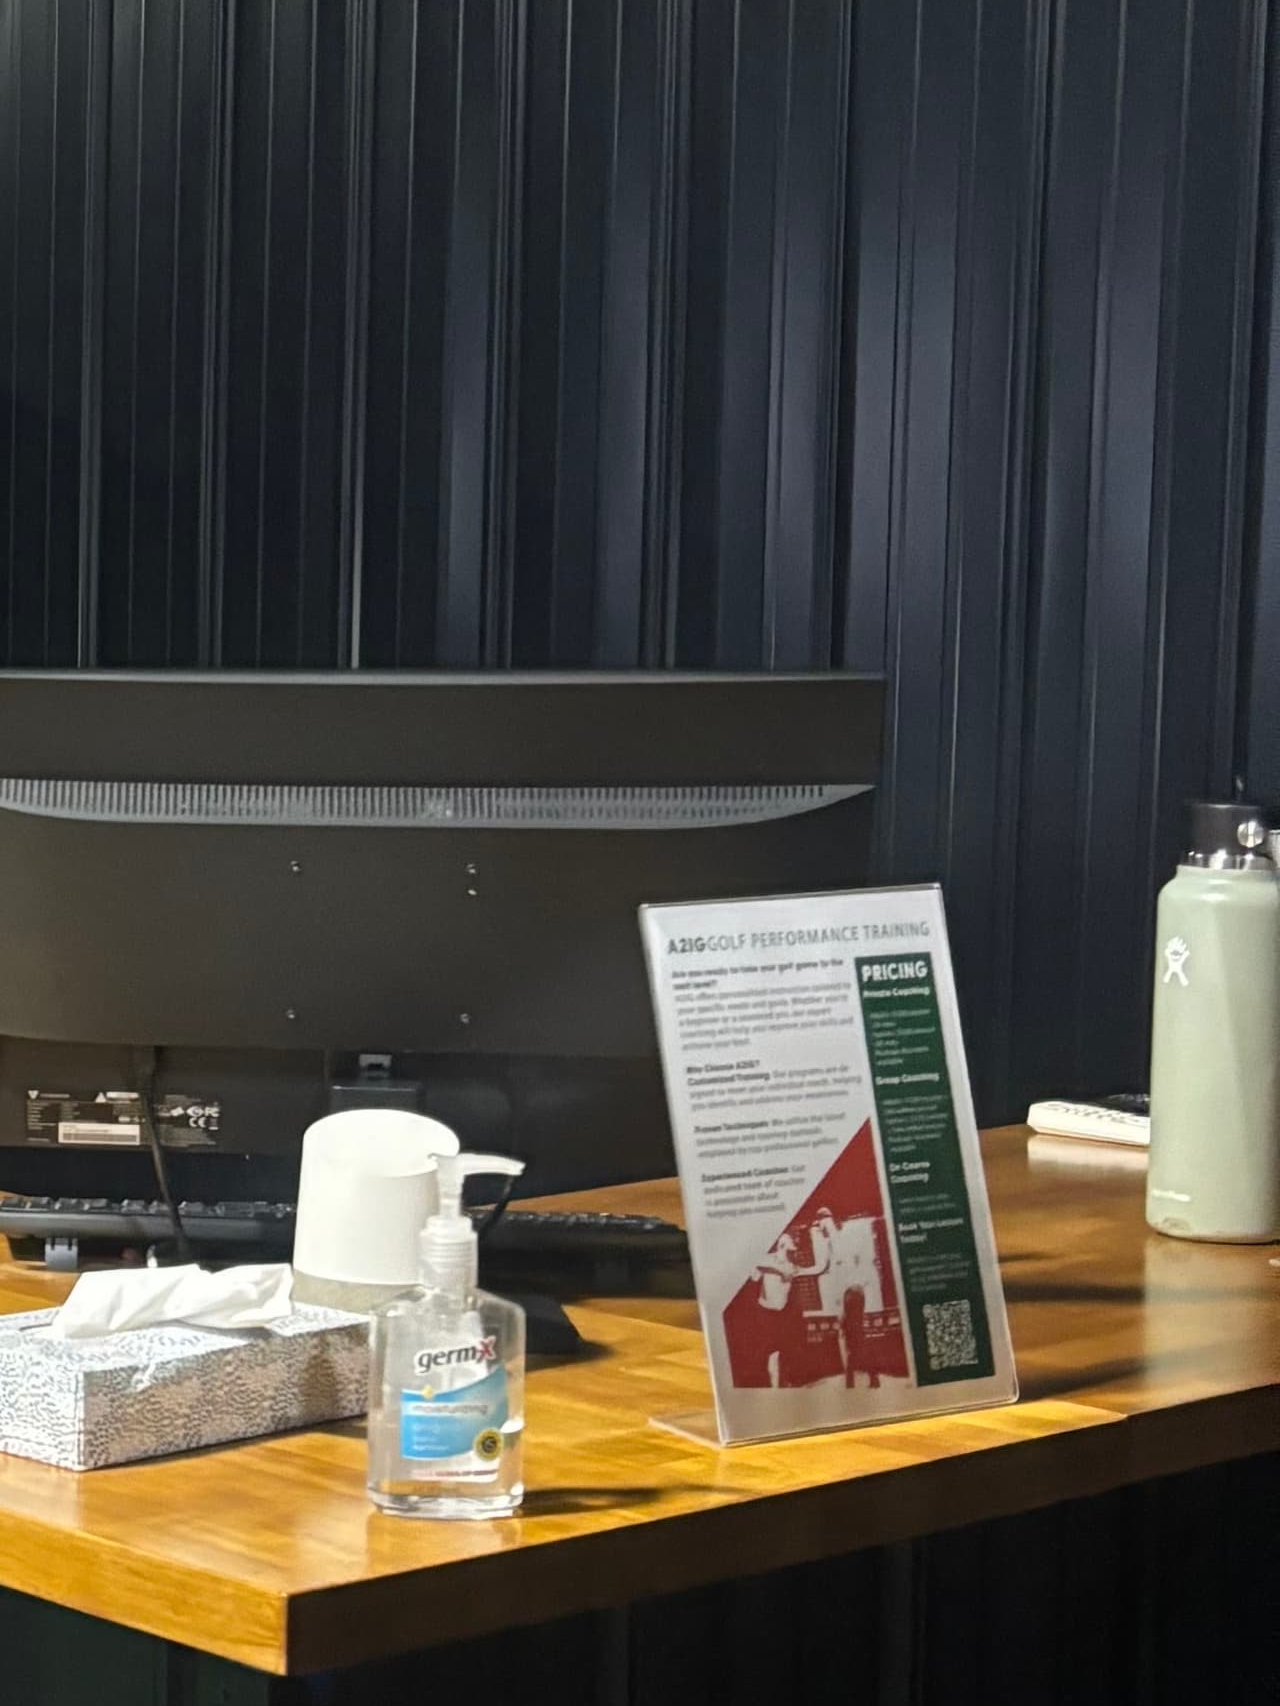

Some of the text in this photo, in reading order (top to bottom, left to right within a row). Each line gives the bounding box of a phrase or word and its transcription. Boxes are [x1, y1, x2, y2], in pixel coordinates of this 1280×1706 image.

[750, 925, 859, 949] PERFORMANCE
[863, 921, 930, 942] TRAINING
[861, 960, 928, 982] PRICING
